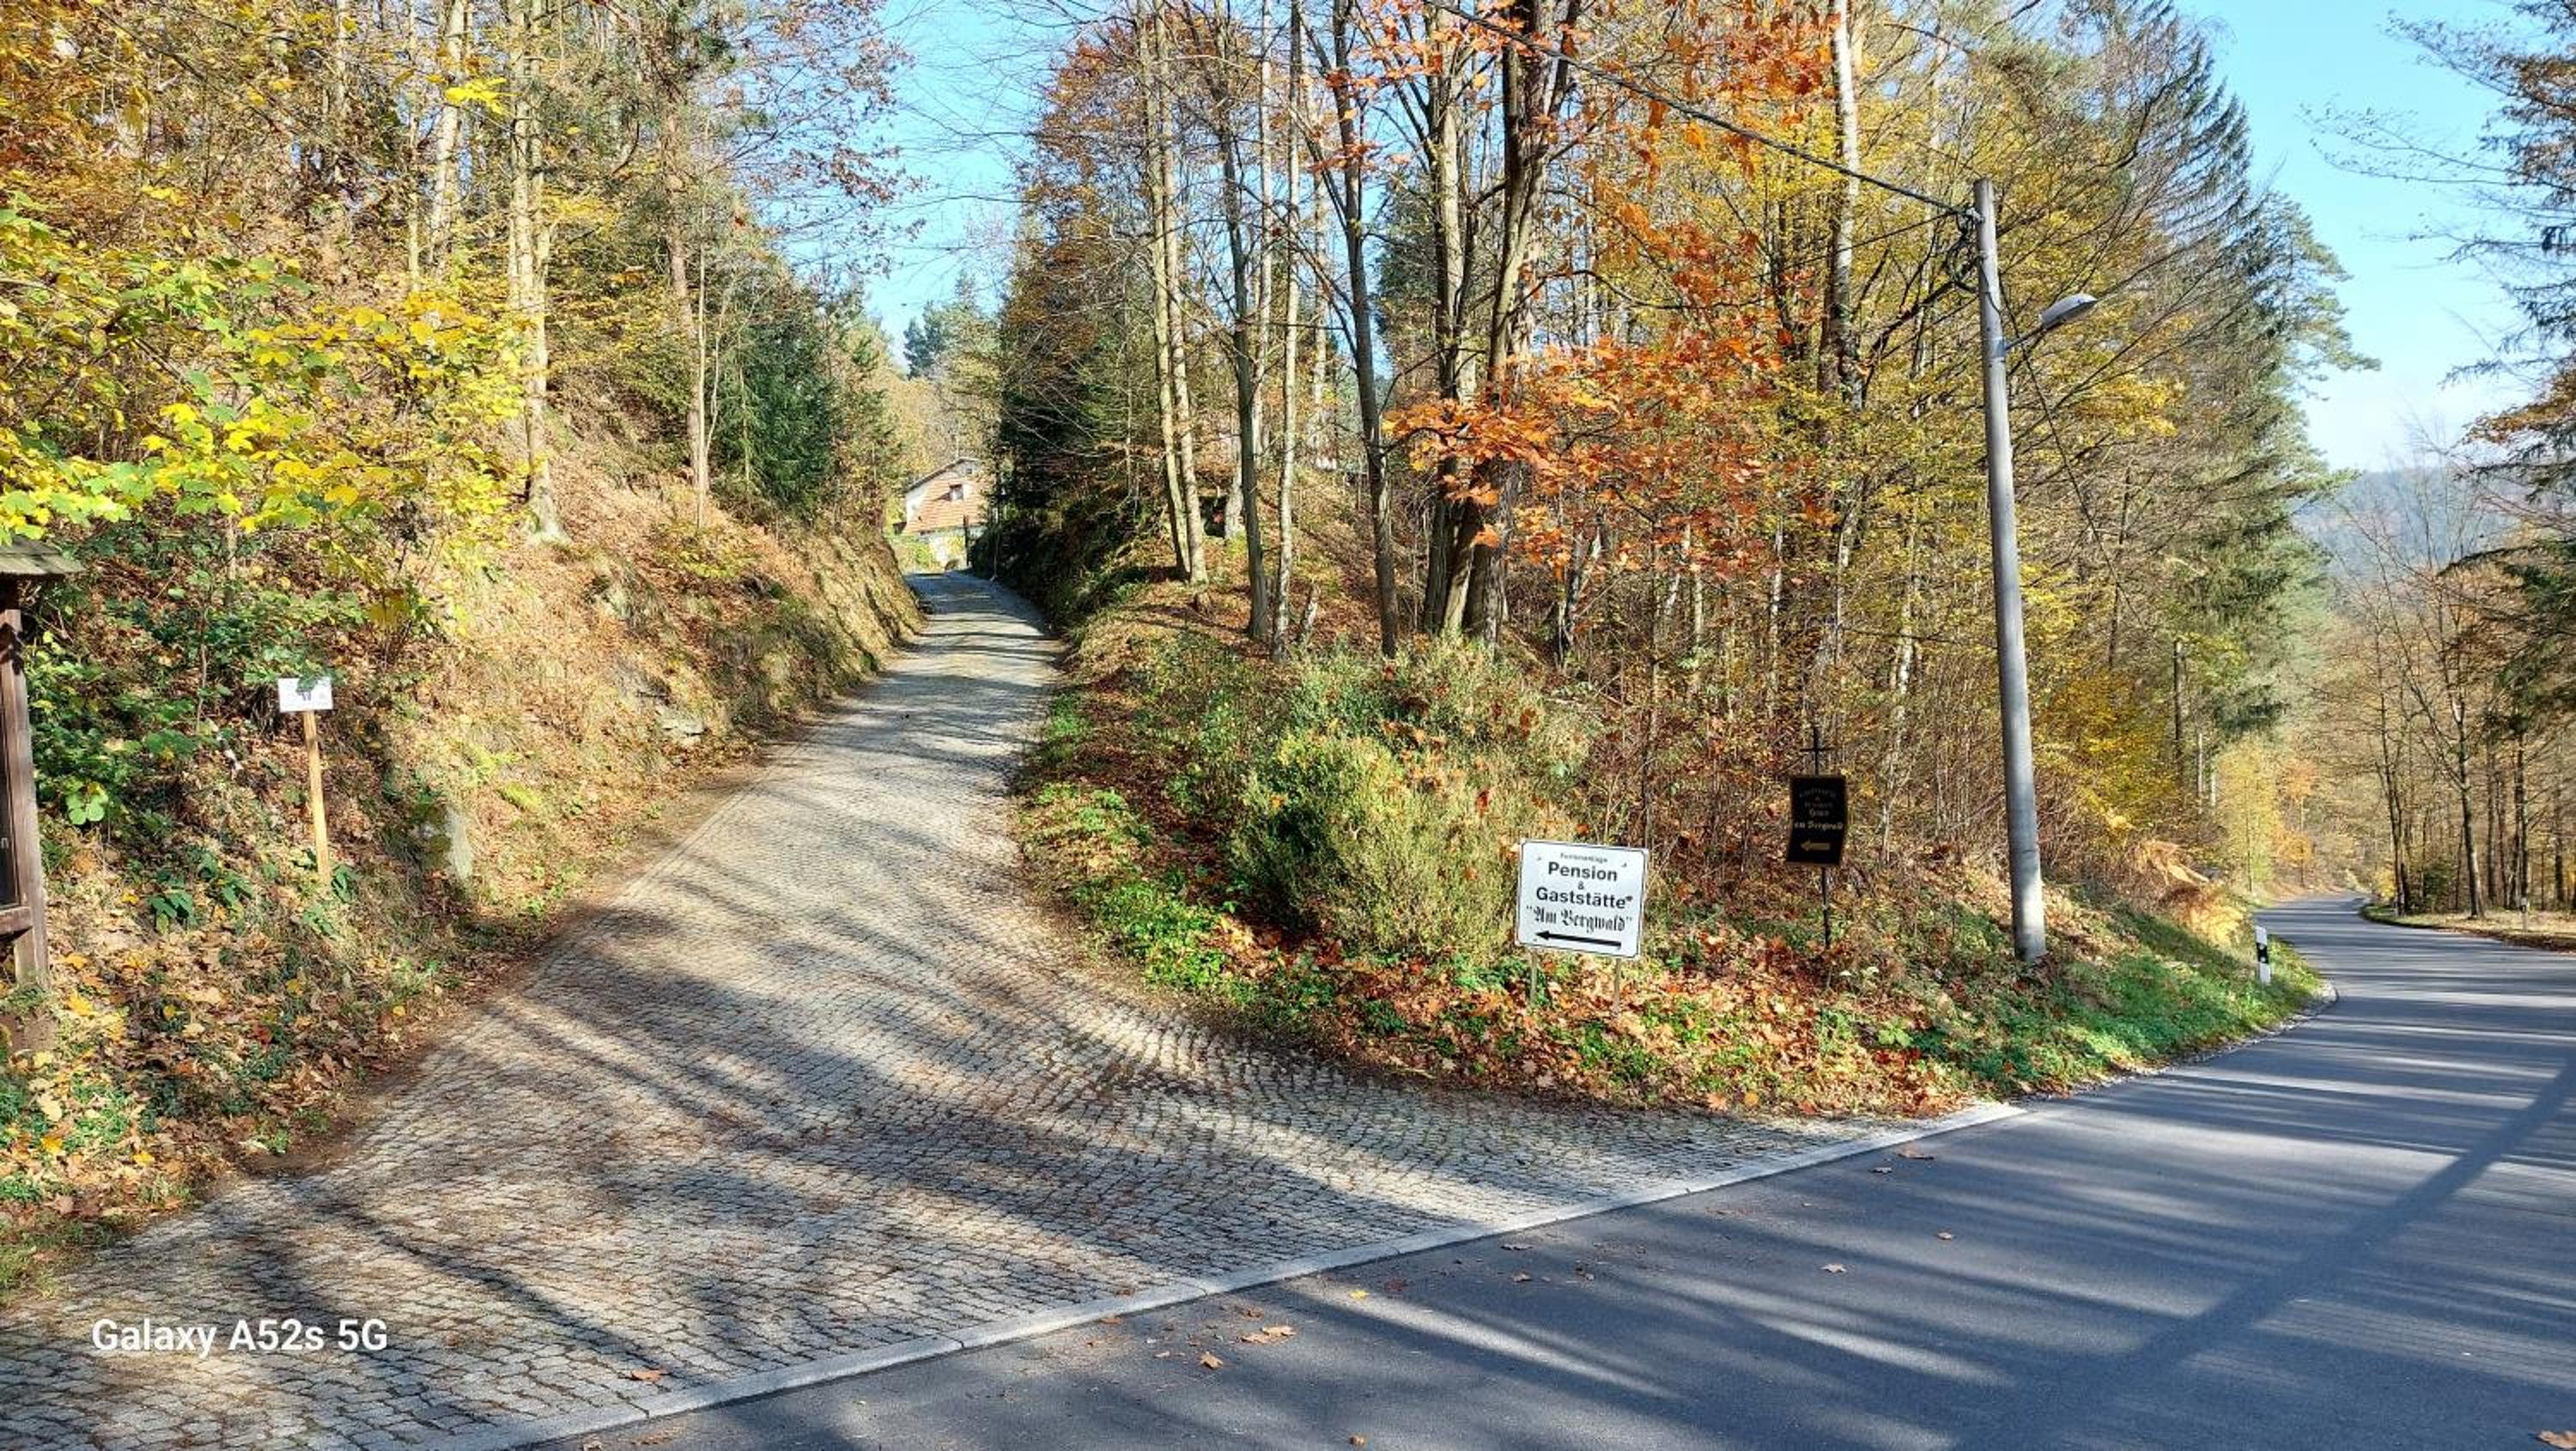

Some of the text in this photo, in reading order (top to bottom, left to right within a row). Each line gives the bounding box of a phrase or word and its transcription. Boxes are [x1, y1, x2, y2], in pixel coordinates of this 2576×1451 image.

[1548, 861, 1618, 882] Pension
[1577, 881, 1585, 890] &
[1535, 887, 1626, 909] Gaststätte
